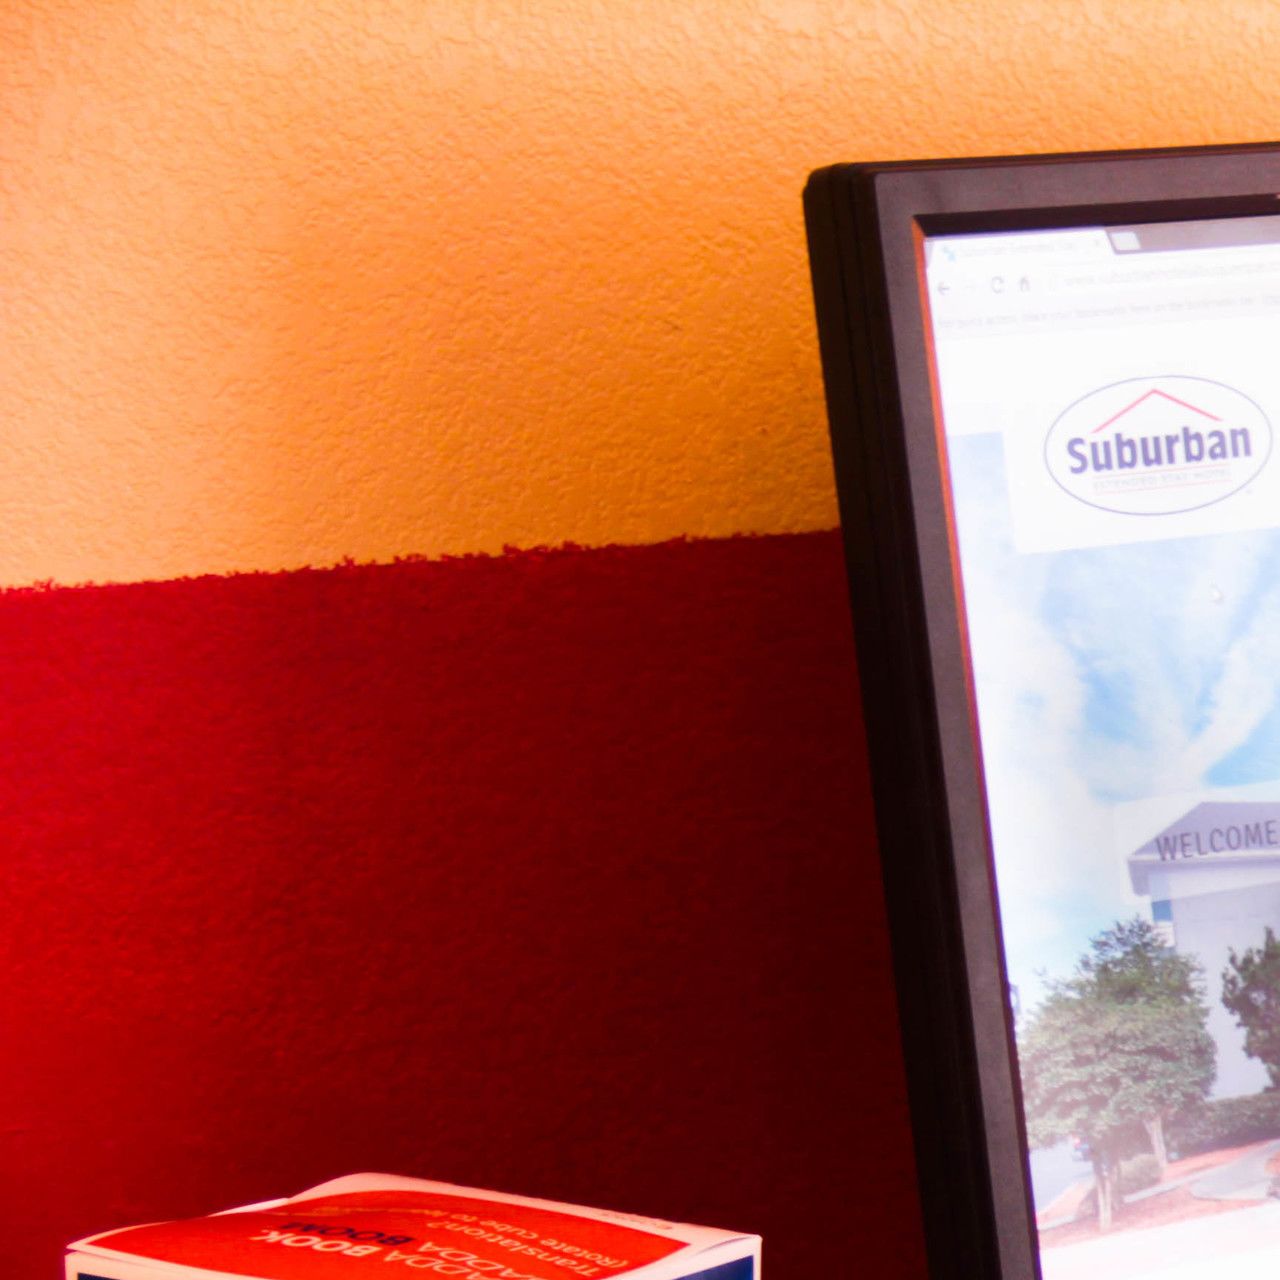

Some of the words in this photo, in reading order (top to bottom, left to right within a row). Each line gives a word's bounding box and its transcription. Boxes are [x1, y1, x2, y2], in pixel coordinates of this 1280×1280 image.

[1066, 425, 1253, 476] Suburban
[1154, 818, 1279, 862] WELCOME
[427, 1220, 600, 1278] Translation?
